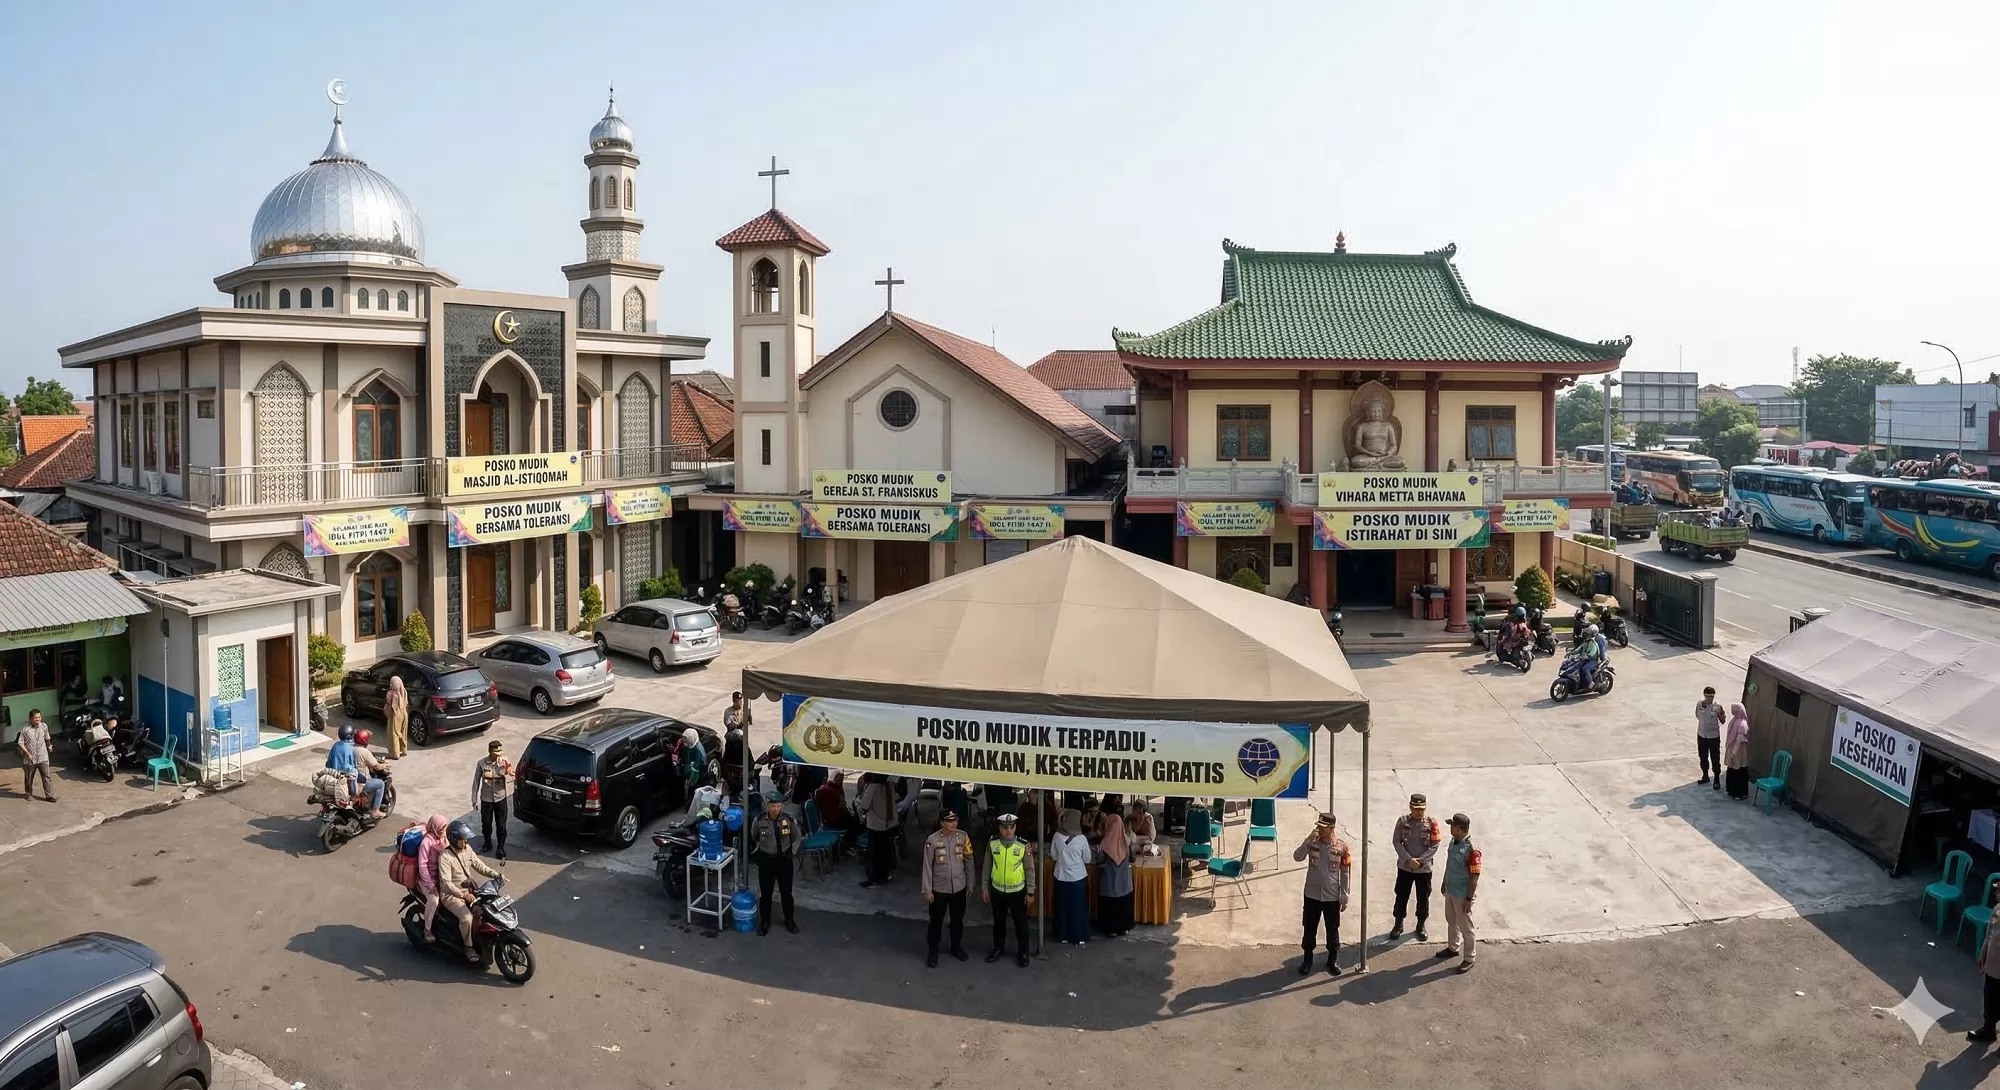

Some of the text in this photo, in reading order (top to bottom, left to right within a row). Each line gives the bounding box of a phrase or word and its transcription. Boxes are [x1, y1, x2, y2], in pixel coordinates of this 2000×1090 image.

[485, 458, 549, 472] POSKO MUDIK
[464, 471, 568, 488] MASJID AL-ISTIQOMAH
[847, 474, 914, 485] POSKO MUDIK
[1363, 477, 1438, 488] POSKO MUDIK
[823, 486, 938, 498] GEREJA ST. FRANSISKUS
[1336, 491, 1466, 502] VIHARA METTA BHAVANA
[485, 501, 562, 519] POSKO MUDIK
[837, 508, 921, 520] POSKO MUDIK
[476, 514, 570, 534] BERSAMA TOLERANSI
[1353, 514, 1451, 526] POSKO MUDIK
[828, 521, 931, 533] BERSAMA TOLERANSI
[1346, 528, 1457, 541] ISTIRAHAT DI SINI
[917, 717, 980, 742] POSKO
[986, 722, 1051, 748] MUDIK
[1056, 727, 1146, 753] TERPADU
[1854, 720, 1896, 756] POSKO
[853, 737, 1225, 784] ISTIRAHAT, MAKAN, KESEHATAN GRATIS
[1839, 737, 1907, 787] KESEHATAN
